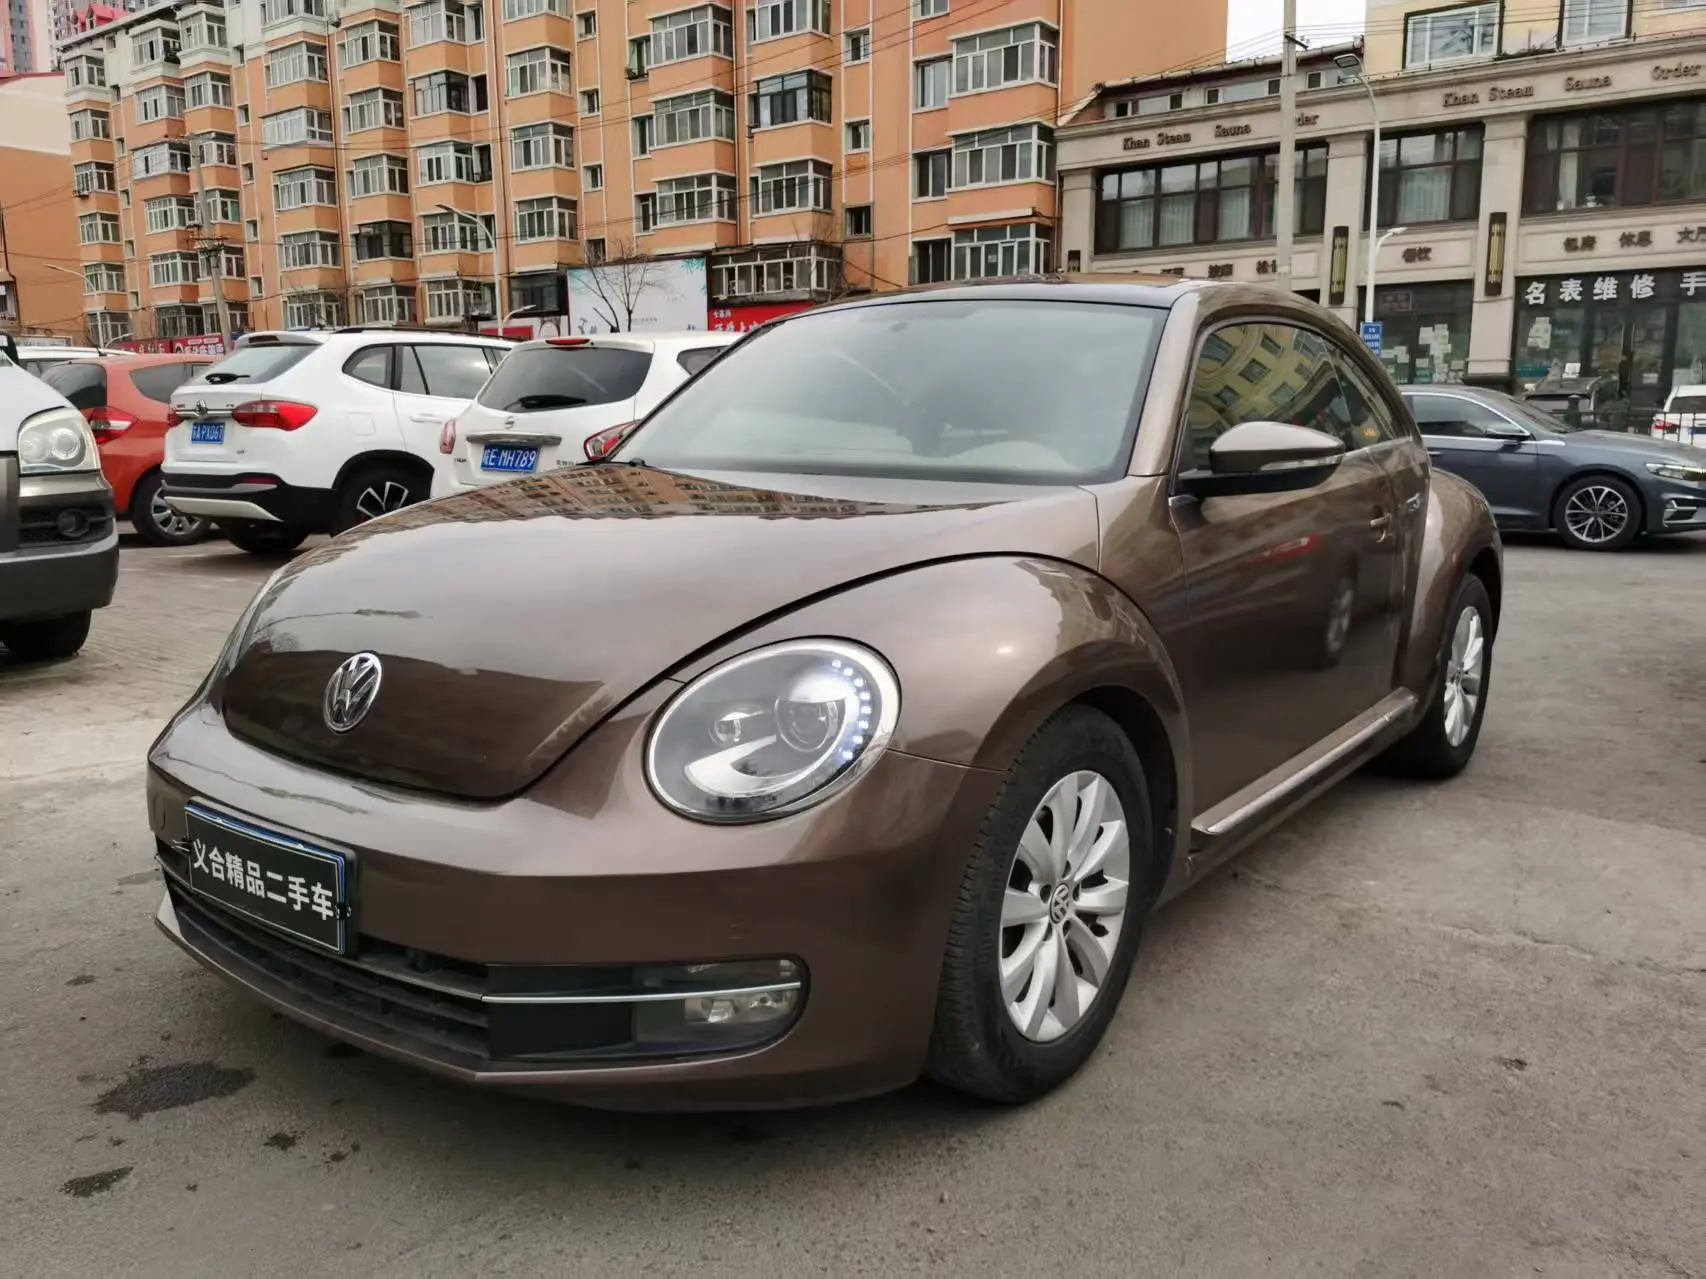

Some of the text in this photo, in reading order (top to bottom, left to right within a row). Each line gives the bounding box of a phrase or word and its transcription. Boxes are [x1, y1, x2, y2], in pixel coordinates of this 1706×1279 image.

[1443, 62, 1701, 107] Khan Steam Sauna Order
[1123, 137, 1150, 151] Khan
[1295, 112, 1319, 128] der
[1619, 230, 1653, 248] 休息
[1525, 274, 1655, 305] 名表维修
[193, 838, 334, 921] 义合精品二手车
